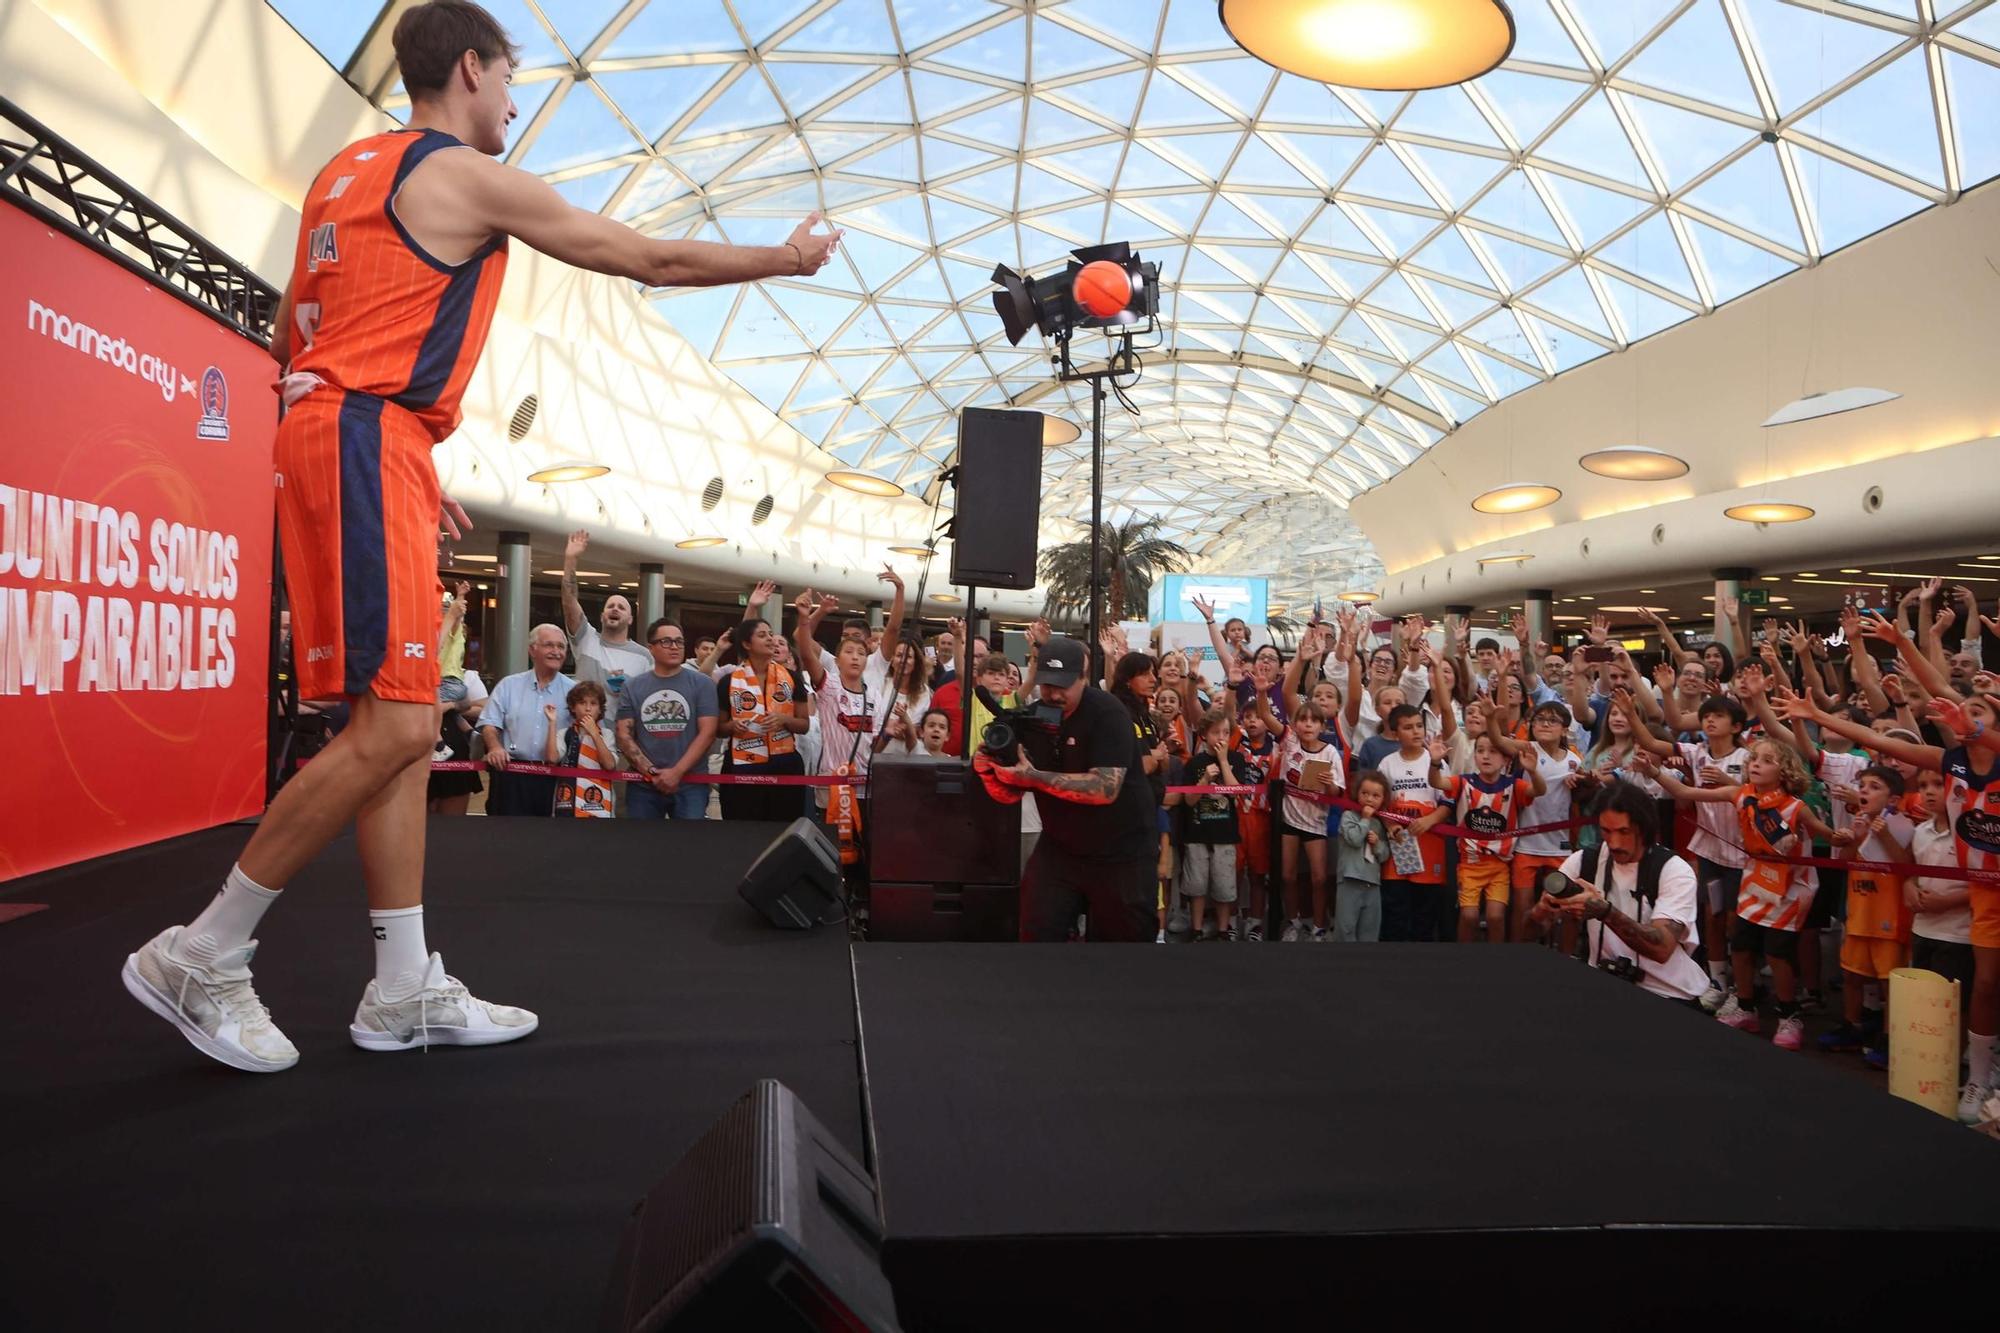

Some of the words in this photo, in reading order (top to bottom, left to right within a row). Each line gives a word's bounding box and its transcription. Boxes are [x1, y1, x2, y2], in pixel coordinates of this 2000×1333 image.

[28, 299, 137, 375] marineda
[139, 353, 176, 402] city
[0, 484, 141, 588] JUNTOS
[149, 518, 239, 601] SOMOS
[0, 587, 237, 696] IMPARABLES
